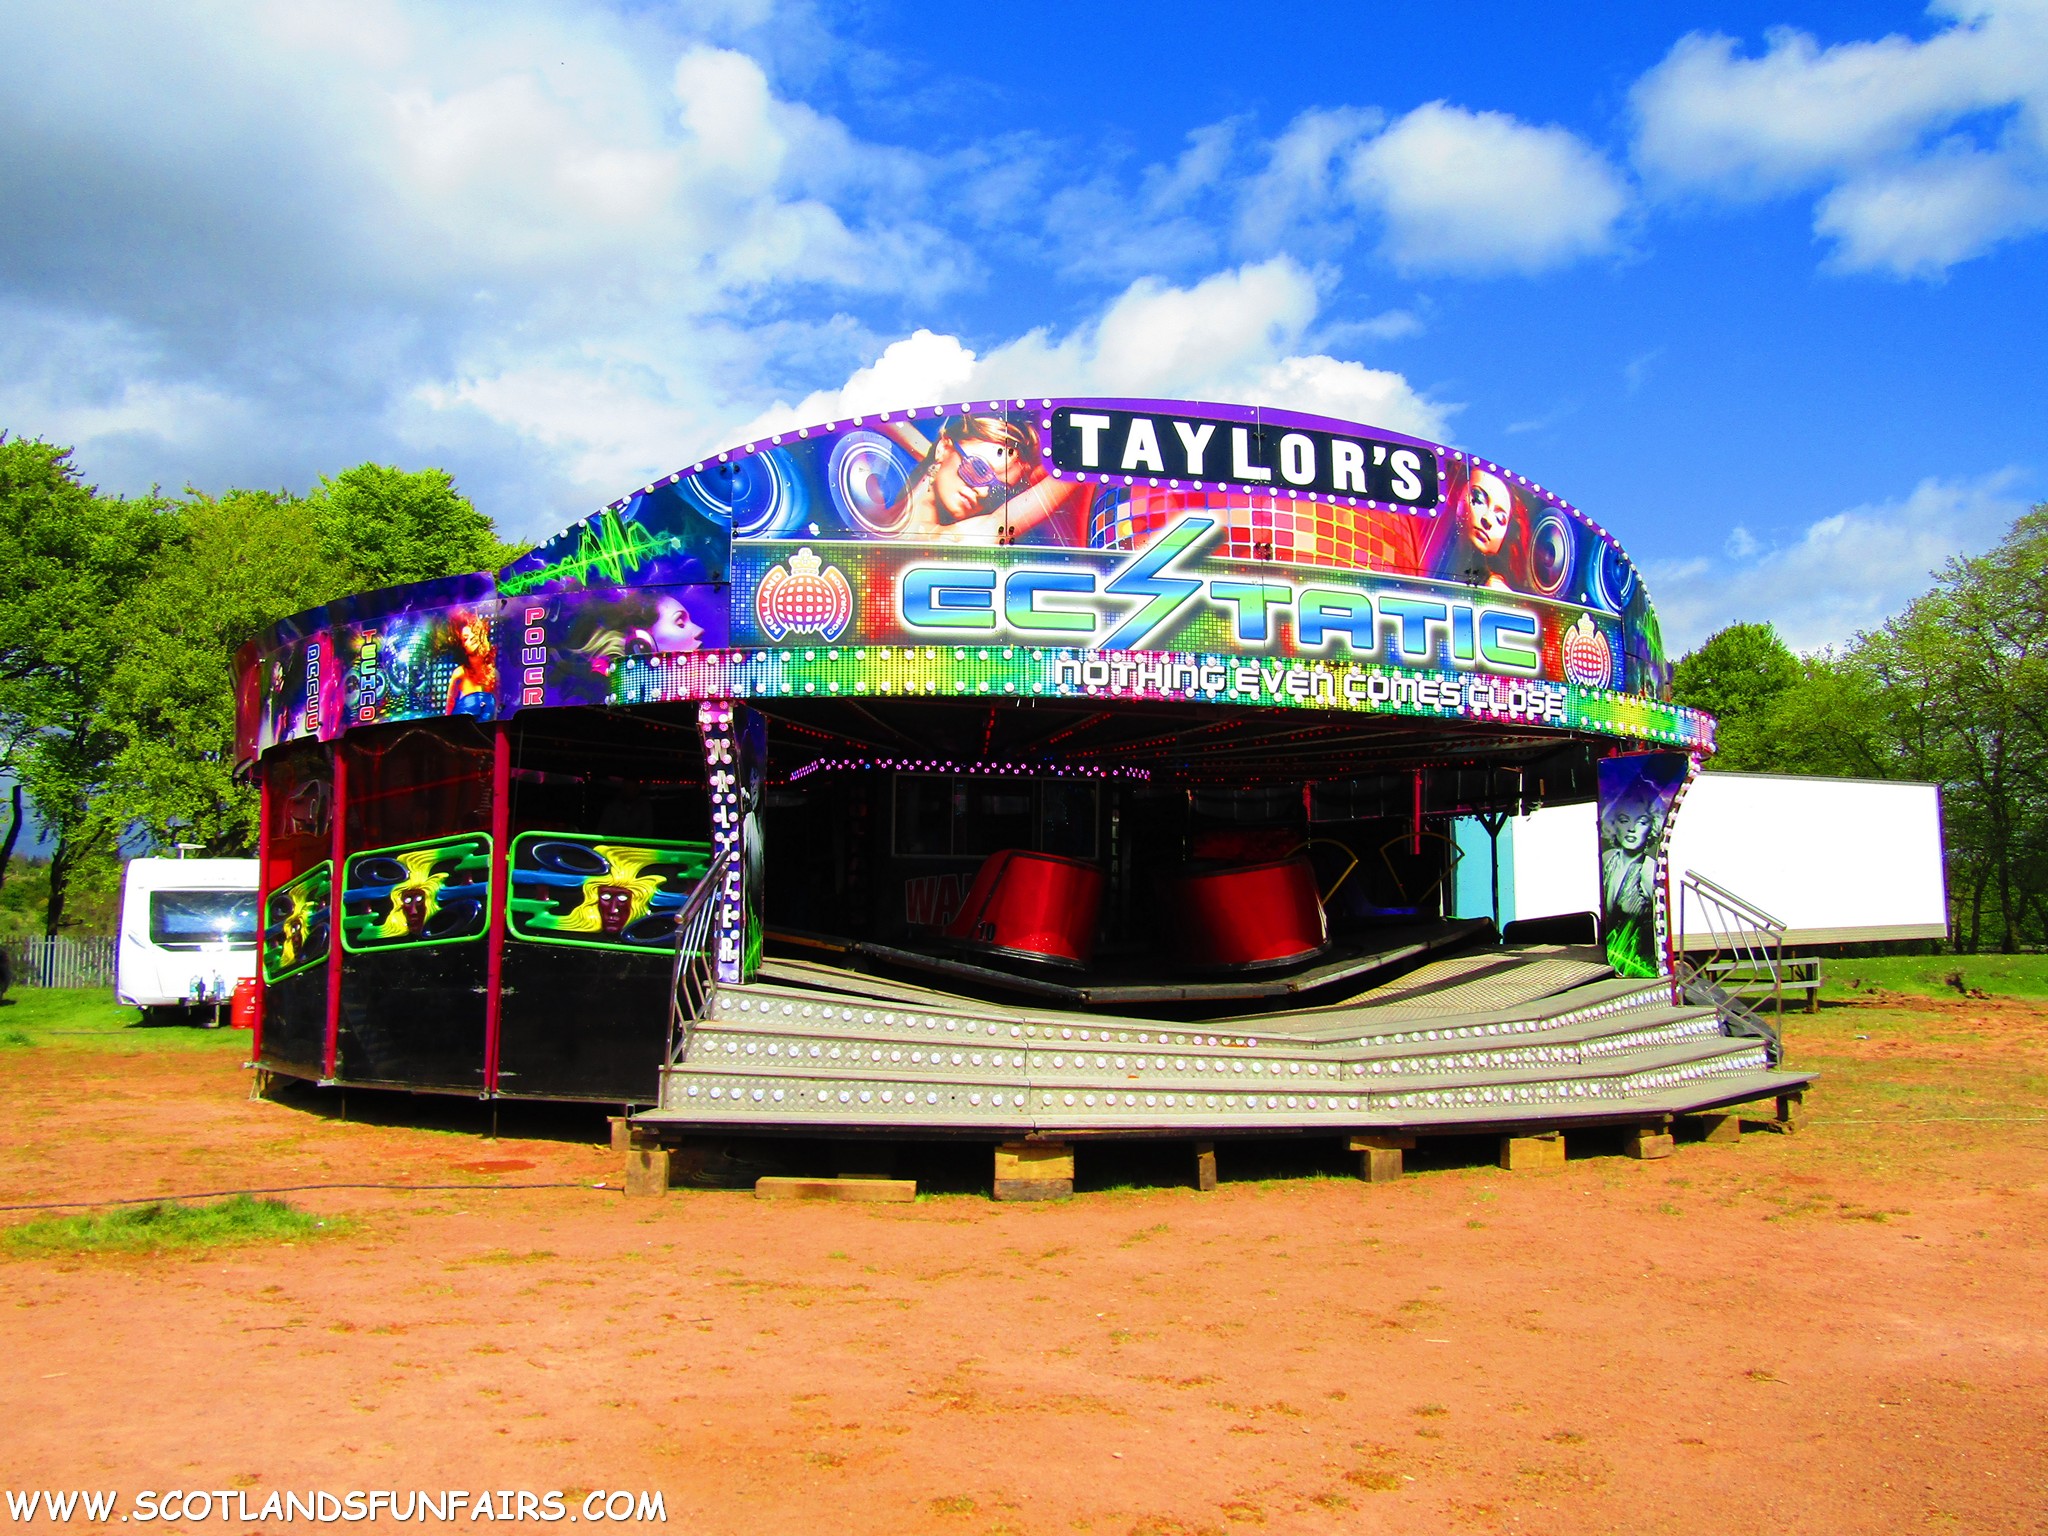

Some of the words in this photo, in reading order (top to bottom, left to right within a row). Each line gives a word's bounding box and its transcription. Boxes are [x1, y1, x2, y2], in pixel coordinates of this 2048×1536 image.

[1069, 413, 1423, 501] TAYLOR'S
[761, 571, 783, 636] HOLLAND
[826, 573, 848, 636] CORPORATION
[305, 643, 320, 732] DANCE
[359, 629, 378, 721] TECHNO
[522, 607, 547, 706] POWER
[1055, 658, 1225, 695] NOTHING
[1235, 668, 1337, 702] EVEN
[1342, 678, 1462, 709] COMES
[1467, 685, 1564, 717] CLOSE
